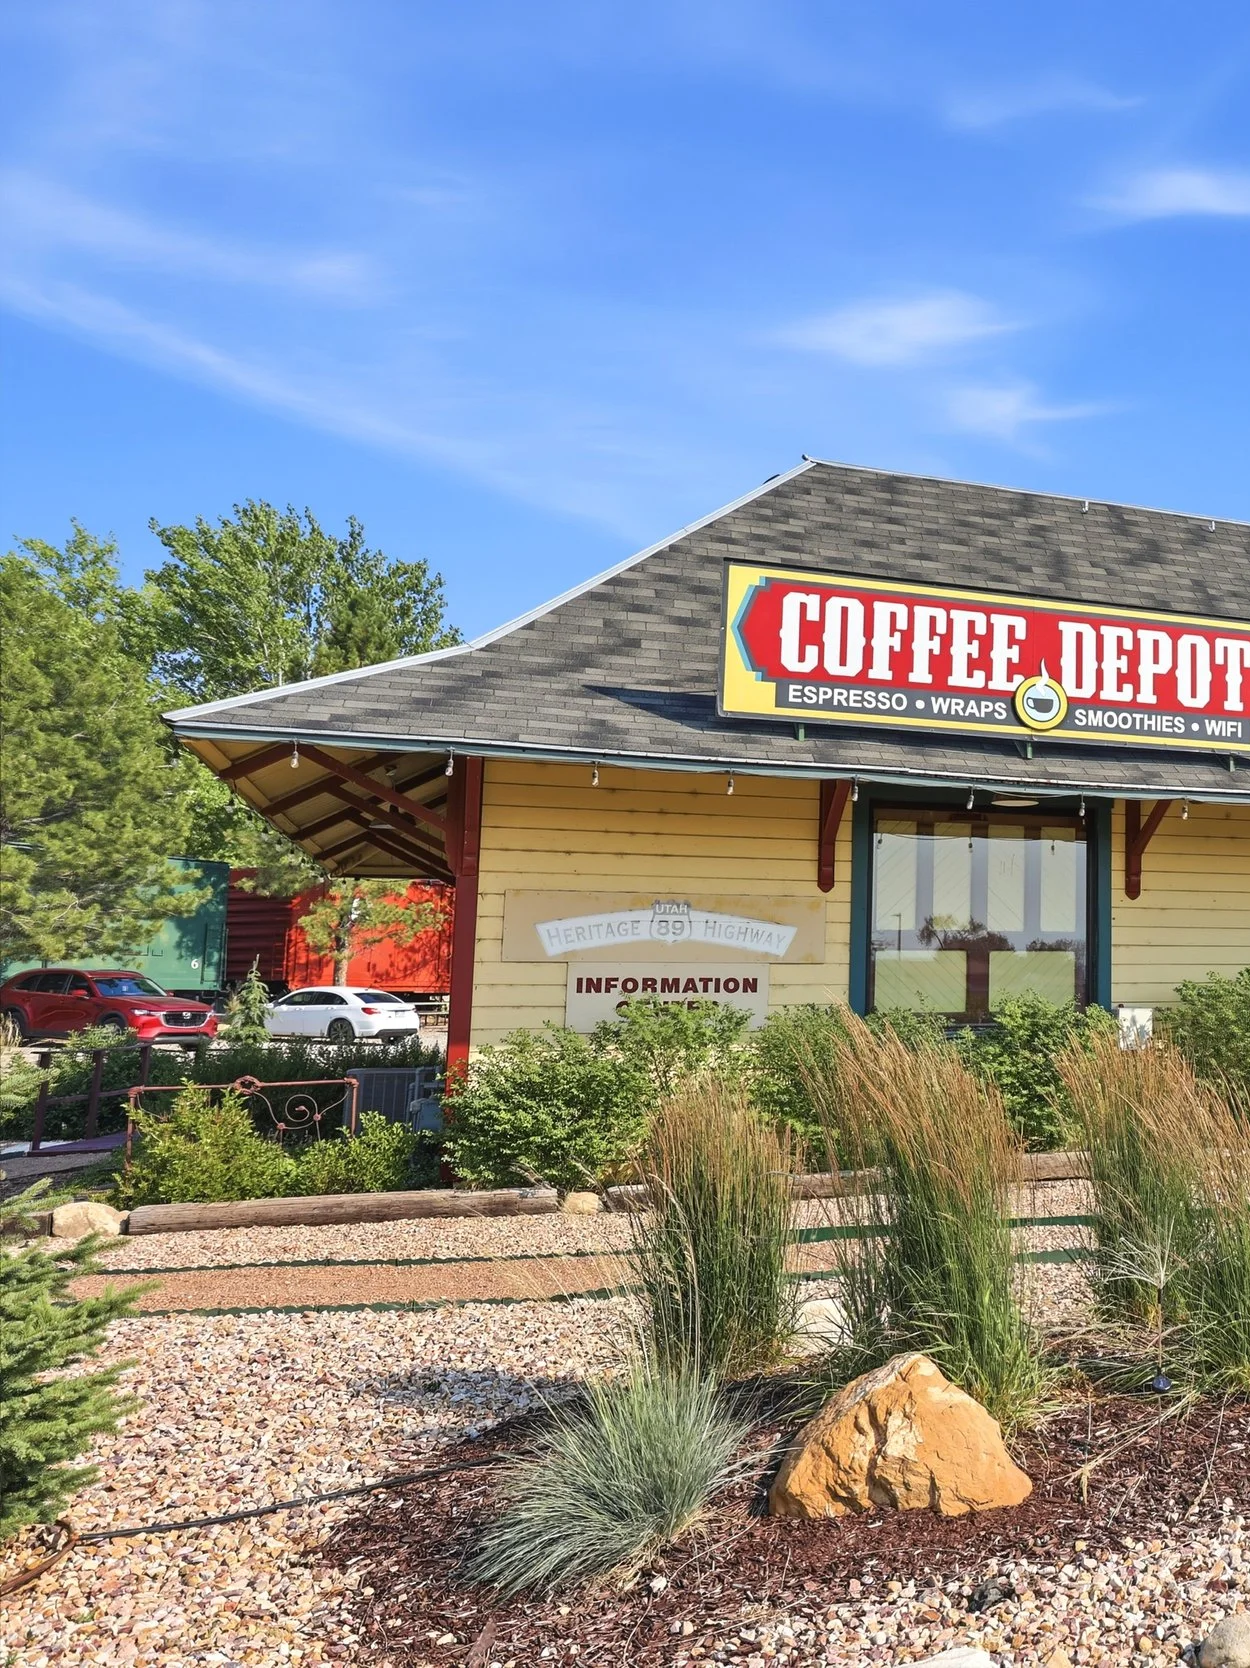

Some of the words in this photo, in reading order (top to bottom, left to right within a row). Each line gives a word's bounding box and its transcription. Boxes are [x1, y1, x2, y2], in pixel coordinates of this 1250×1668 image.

[778, 592, 1027, 692] COFFEE
[788, 684, 908, 711] ESPRESSO
[931, 696, 1008, 720] WRAPS
[1074, 708, 1186, 734] SMOOTHIES
[1205, 719, 1242, 738] WIFI
[655, 903, 688, 914] UTAH
[546, 921, 641, 948] HERITAGE
[656, 919, 686, 937] 89
[703, 919, 787, 950] HIGHWAY
[190, 958, 199, 970] 6
[575, 977, 759, 994] INFORMATION
